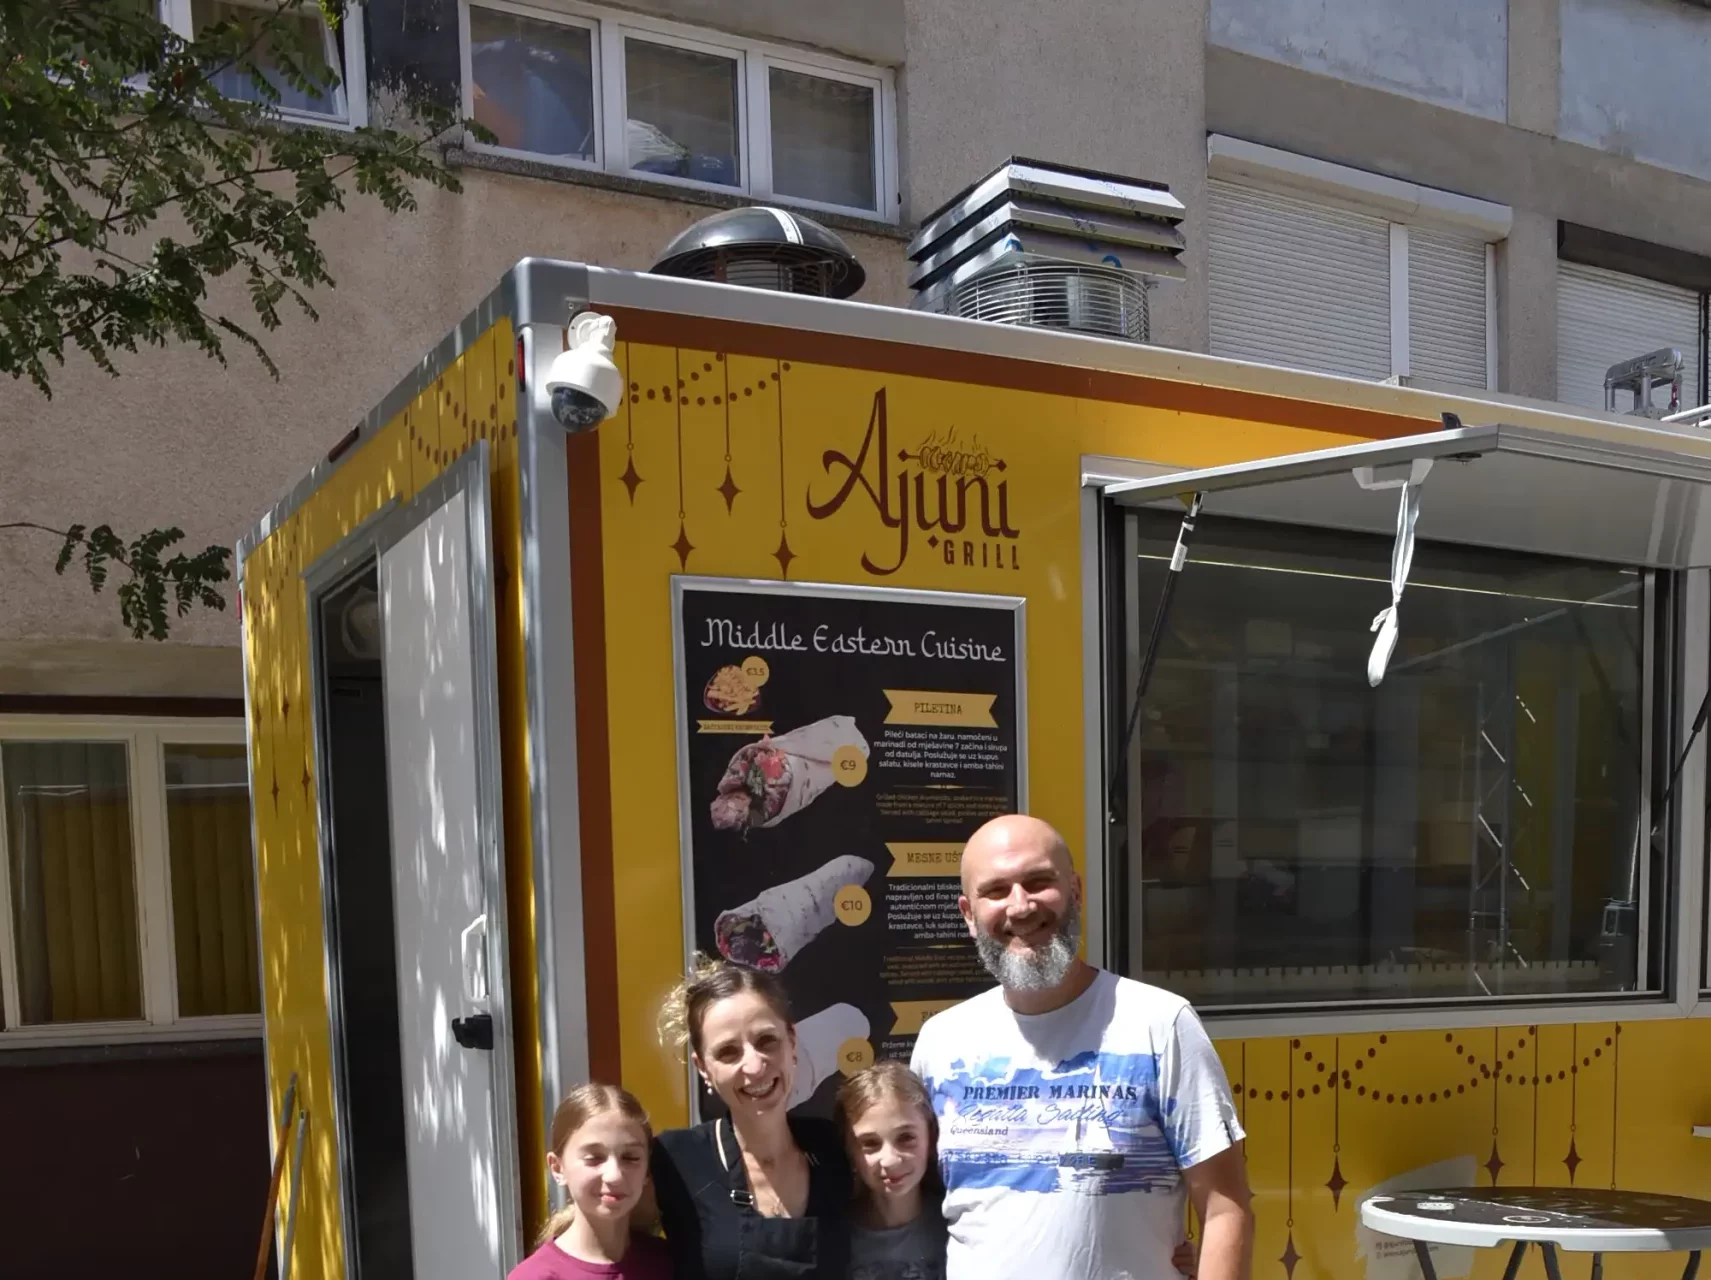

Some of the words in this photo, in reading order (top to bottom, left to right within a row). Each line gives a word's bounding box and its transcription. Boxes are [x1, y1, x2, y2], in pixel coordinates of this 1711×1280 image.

[806, 385, 1020, 576] Ajuni
[943, 539, 1020, 570] GRILL
[701, 618, 808, 651] Middle
[813, 624, 917, 657] Eastern
[921, 630, 1007, 662] Cuisine
[914, 702, 963, 715] PILETINA
[929, 732, 938, 740] na
[993, 734, 998, 742] u
[907, 740, 917, 749] od
[885, 750, 895, 758] od
[924, 751, 958, 761] Poslužuje
[840, 759, 857, 771] €9
[903, 760, 924, 768] kisele
[925, 760, 958, 769] krastavce
[906, 852, 942, 864] MESNE
[888, 883, 936, 891] Tradicionalni
[885, 893, 924, 902] napravljen
[925, 893, 935, 901] od
[936, 892, 950, 900] fine
[841, 900, 863, 911] €10
[887, 912, 922, 921] Poslužuje
[925, 922, 935, 930] luk
[846, 1051, 863, 1063] €8
[963, 1085, 1040, 1100] PREMIER
[1049, 1084, 1138, 1103] MARINAS
[950, 1125, 1009, 1136] Queensland
